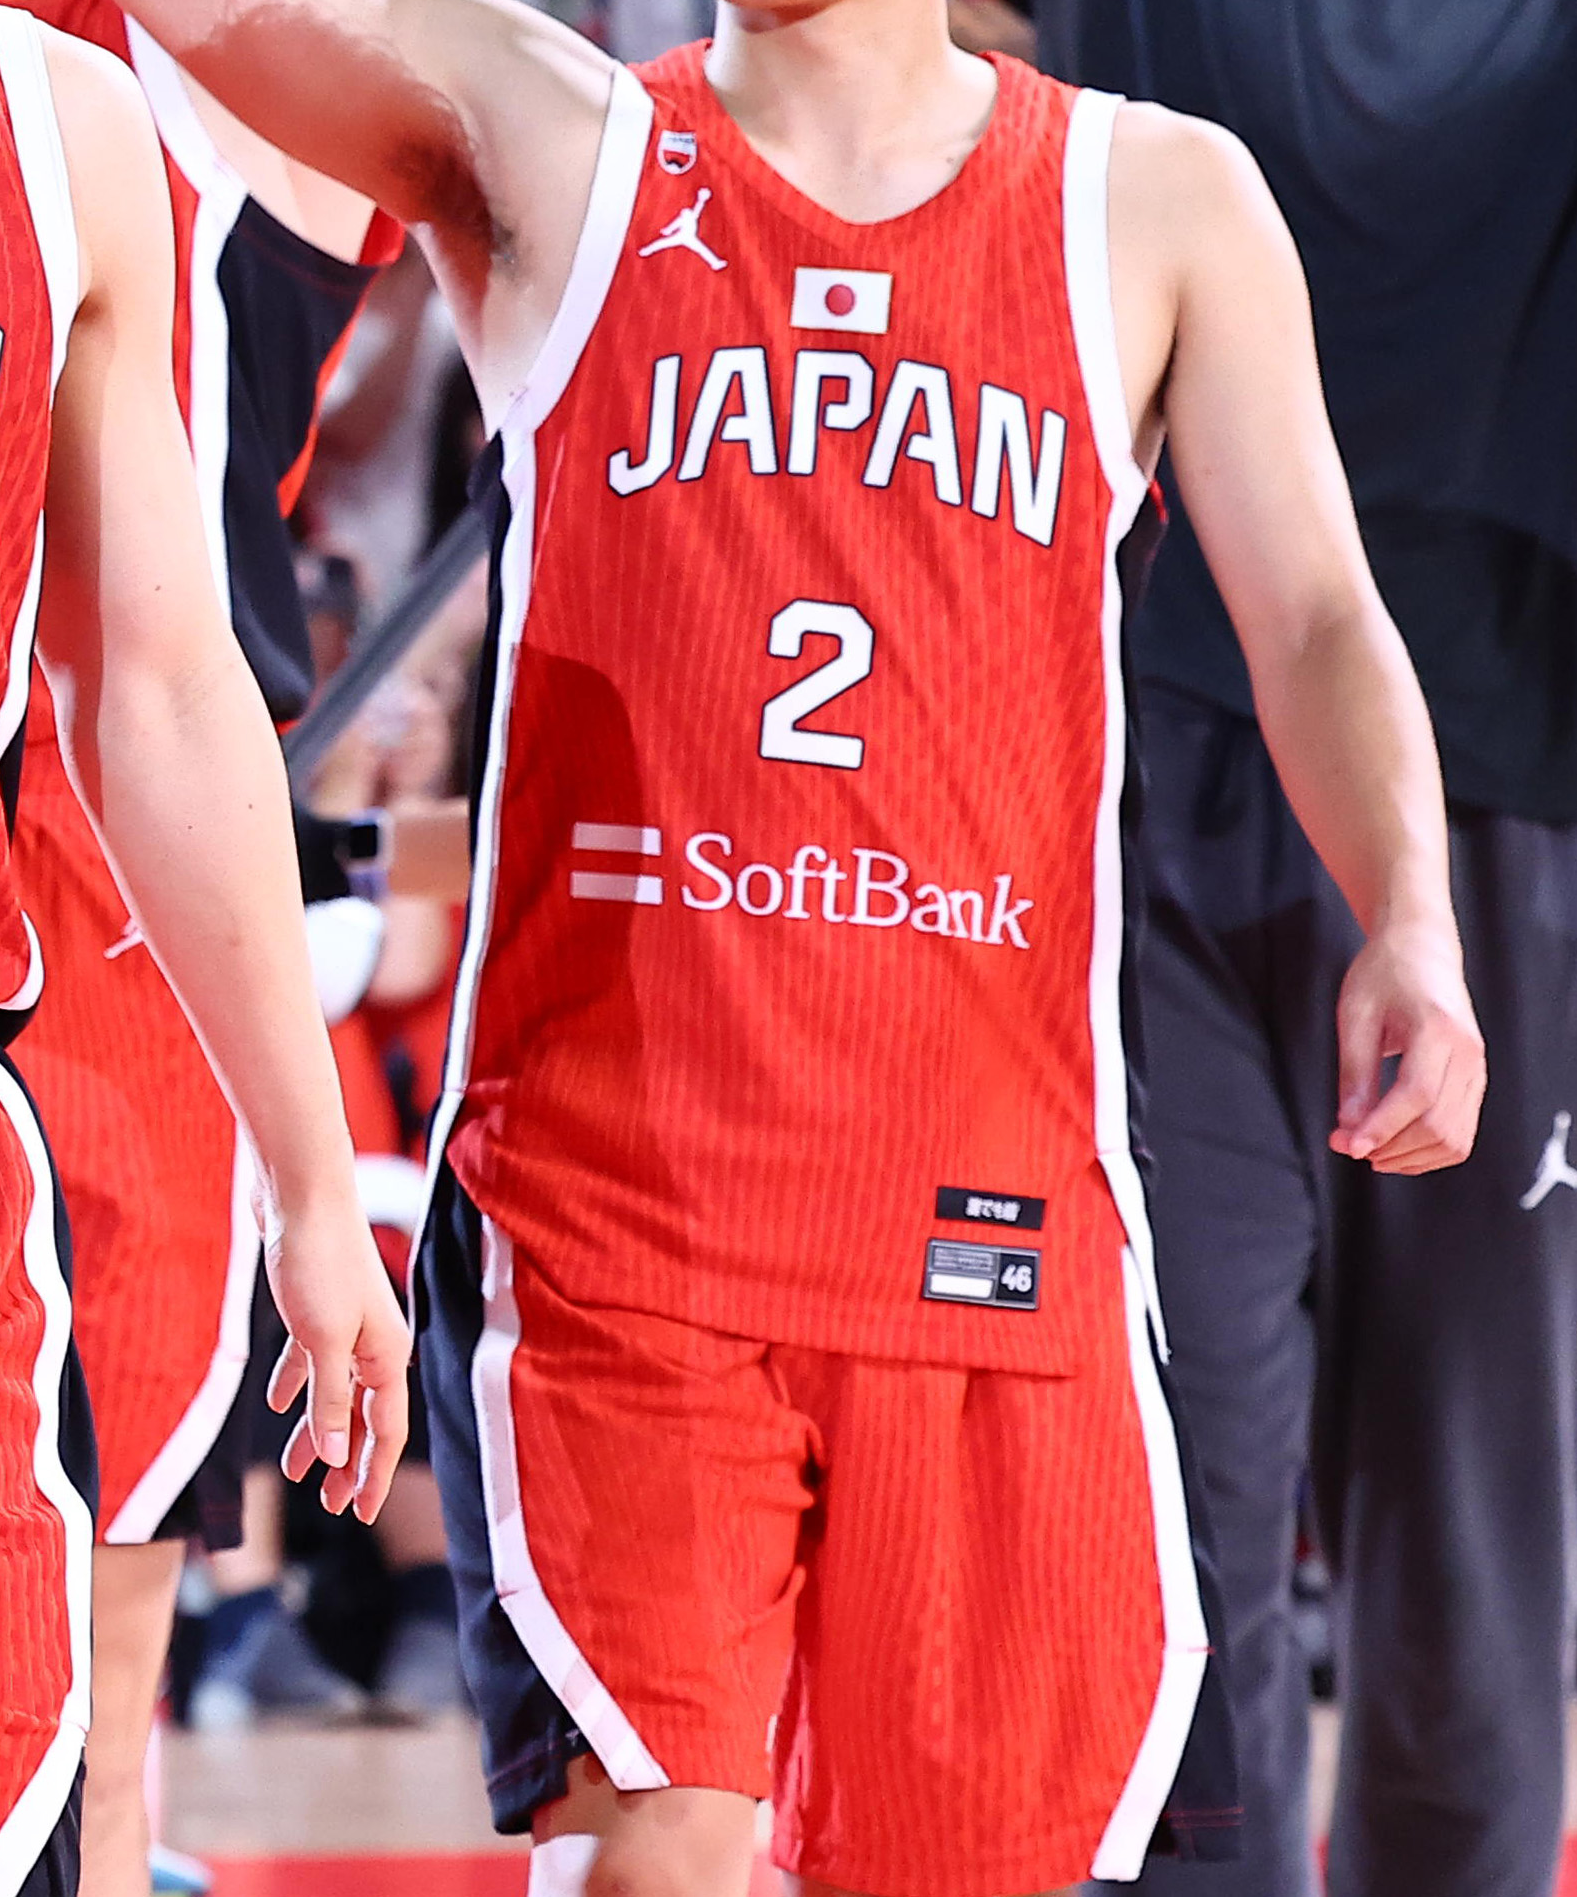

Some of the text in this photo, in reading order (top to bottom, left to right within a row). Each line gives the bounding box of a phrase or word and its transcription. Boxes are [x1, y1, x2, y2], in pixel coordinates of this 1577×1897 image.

[608, 346, 1067, 547] JAPAN
[759, 598, 876, 770] 2
[681, 831, 1034, 949] SoftBank
[1001, 1264, 1032, 1292] 46
